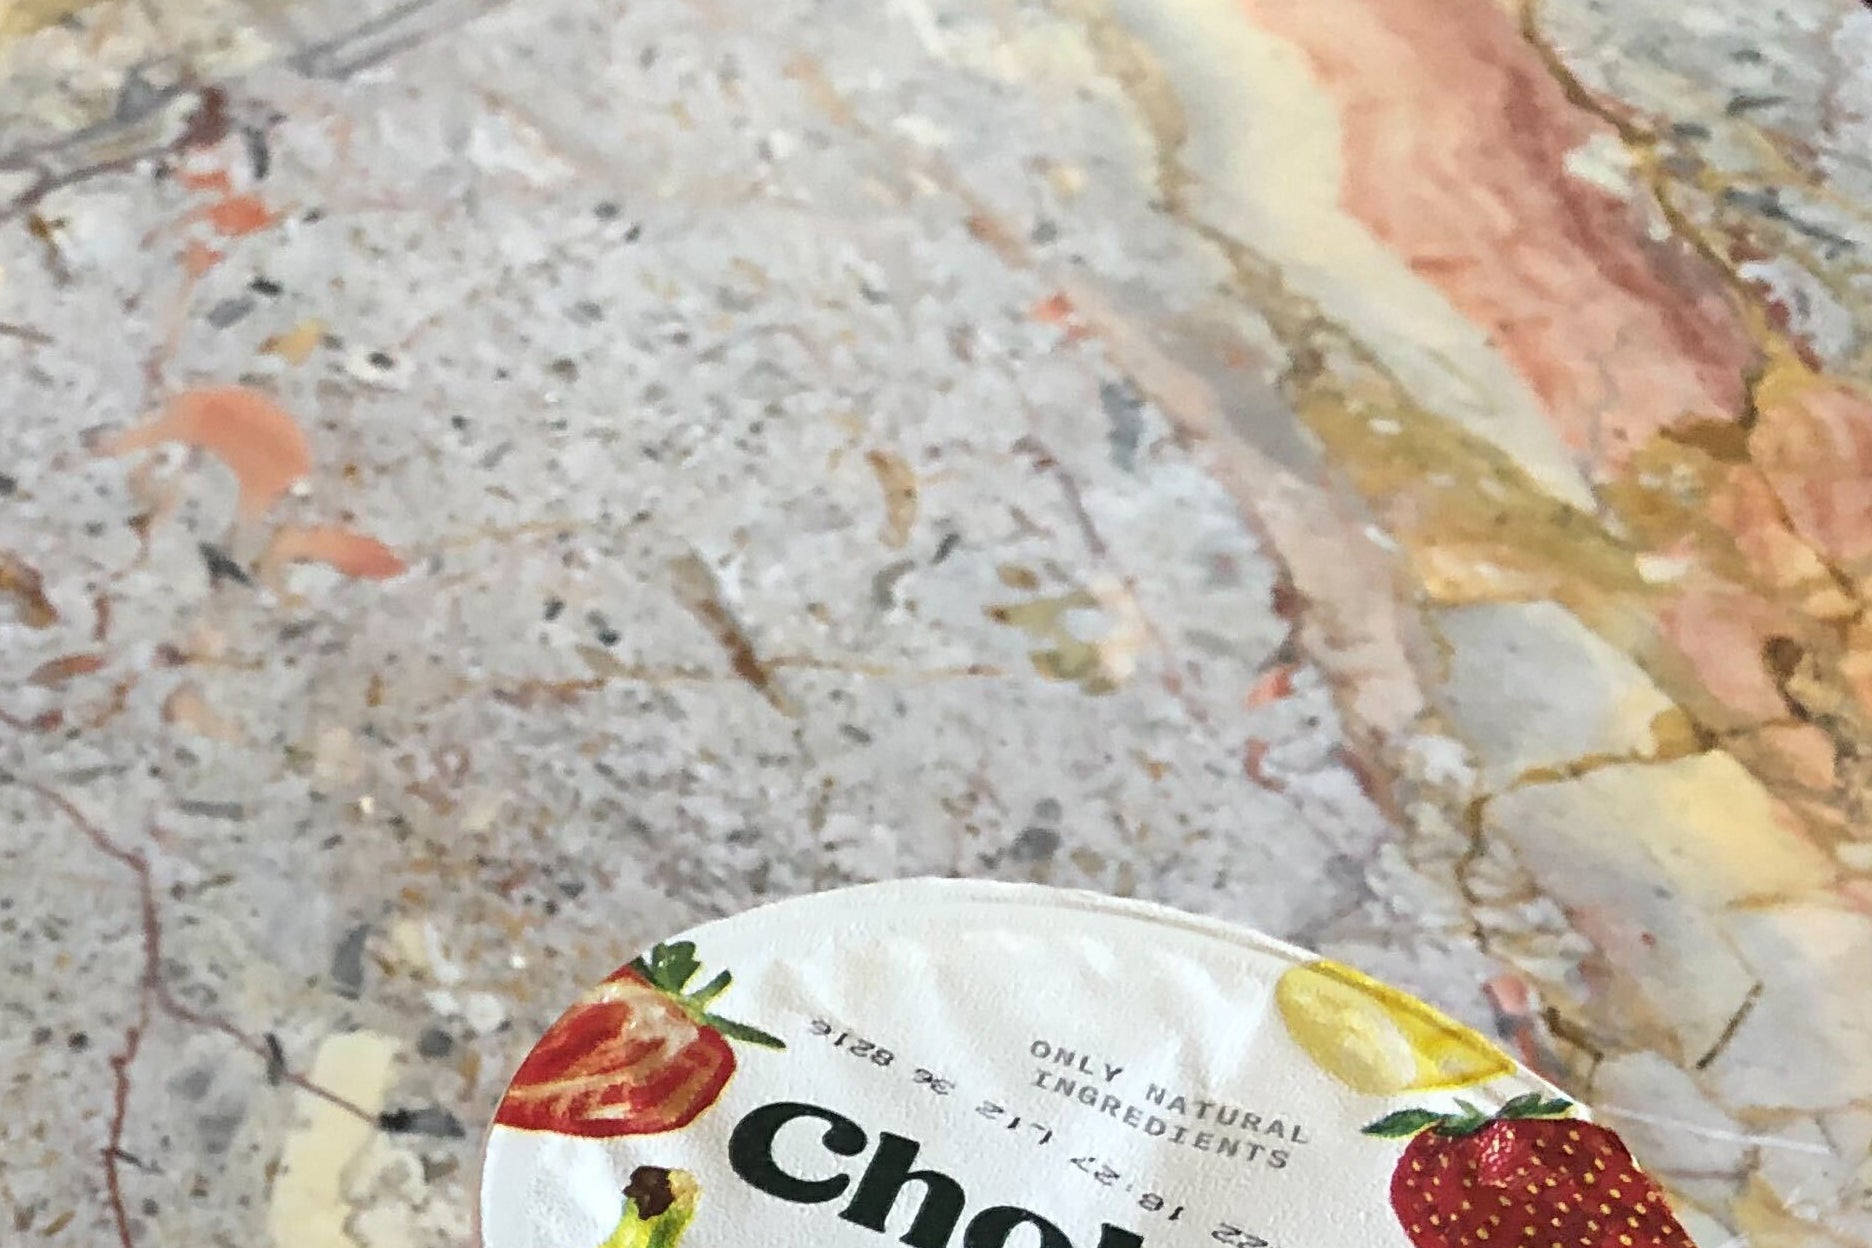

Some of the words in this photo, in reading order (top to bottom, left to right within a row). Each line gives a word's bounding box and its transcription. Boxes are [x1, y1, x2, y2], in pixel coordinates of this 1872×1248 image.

[1029, 1039, 1124, 1083] ONLY
[1144, 1082, 1310, 1145] NATURAL
[1032, 1067, 1291, 1170] INGREDIENTS
